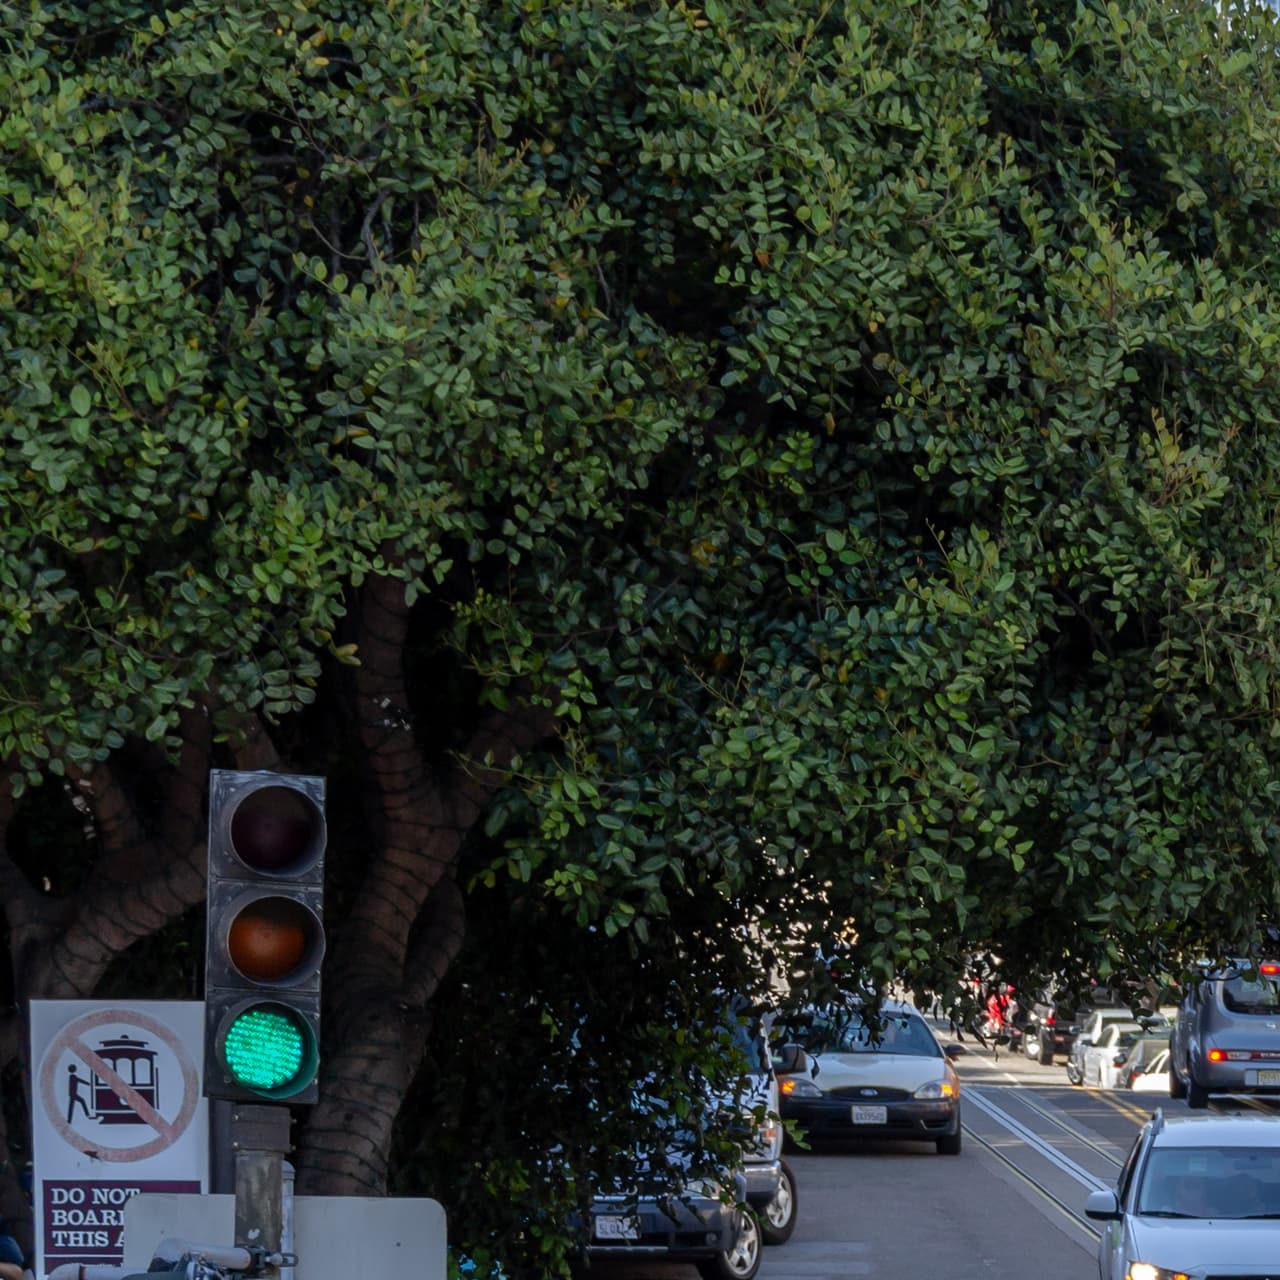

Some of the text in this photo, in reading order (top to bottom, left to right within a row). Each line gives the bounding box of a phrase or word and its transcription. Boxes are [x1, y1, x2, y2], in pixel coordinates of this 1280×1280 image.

[51, 1188, 140, 1204] DO NOT
[53, 1231, 109, 1247] THIS
